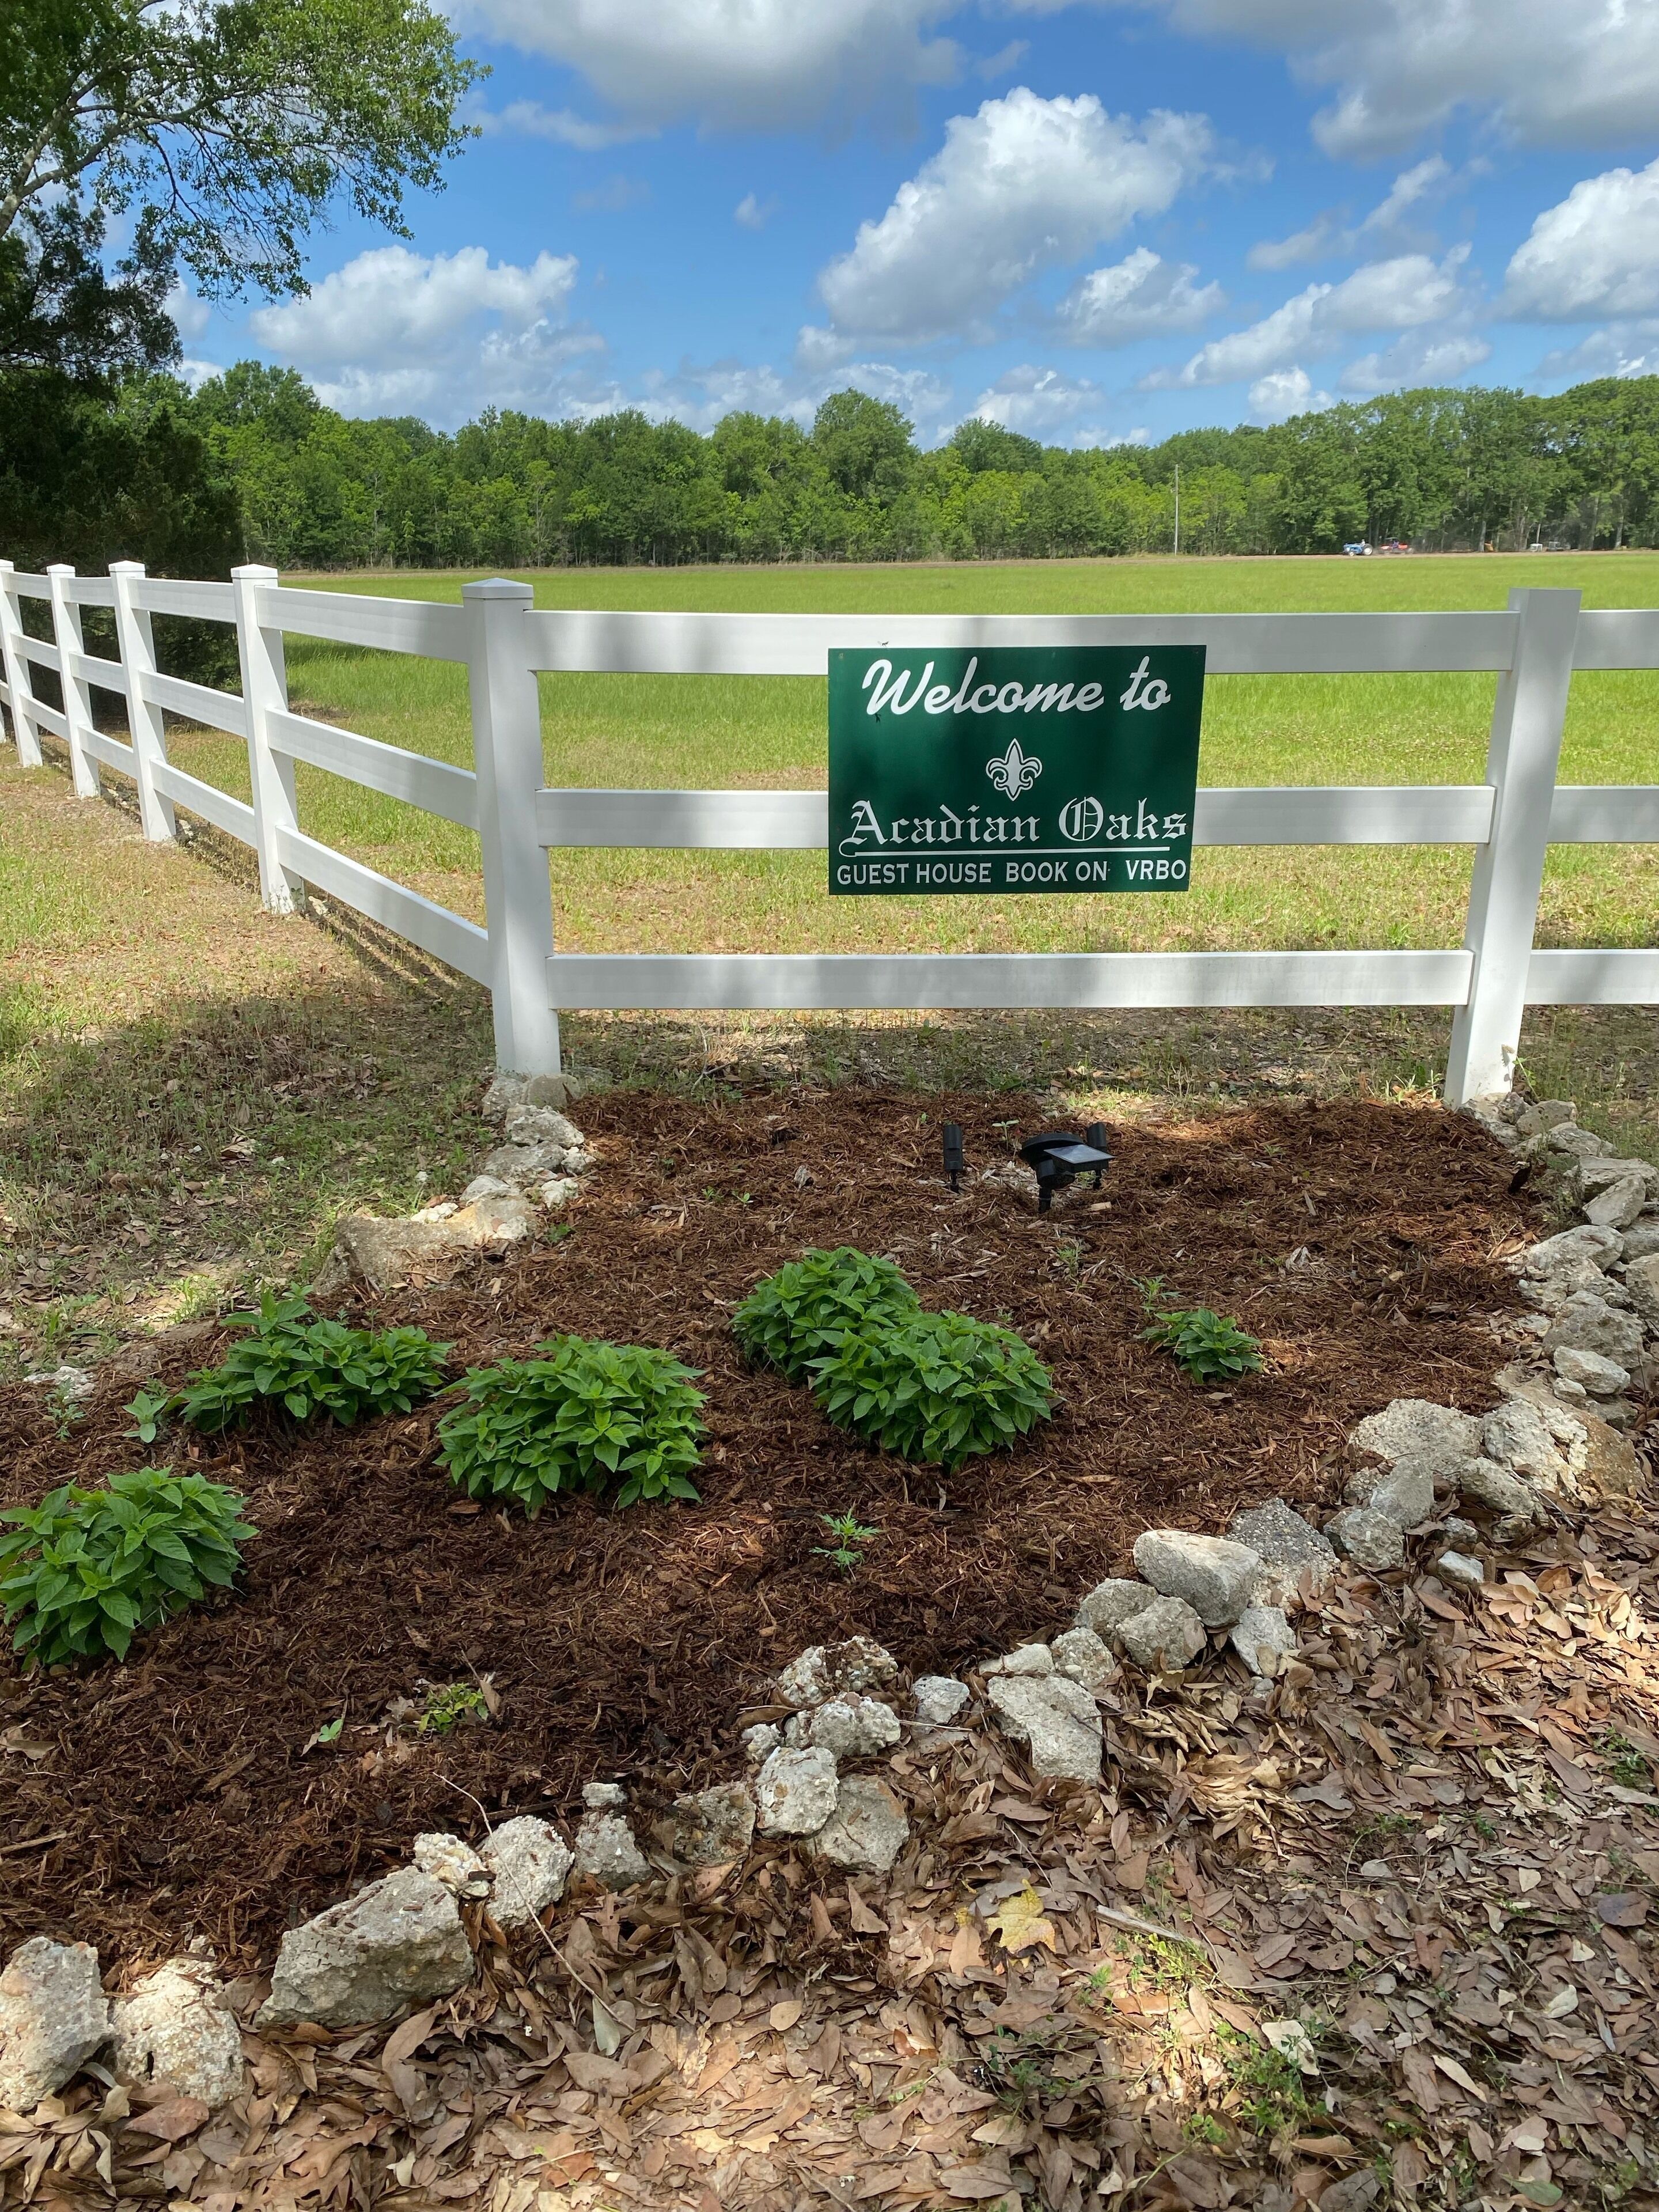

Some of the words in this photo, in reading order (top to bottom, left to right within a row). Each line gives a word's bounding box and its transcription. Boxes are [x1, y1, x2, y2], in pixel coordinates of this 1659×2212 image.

[862, 656, 1104, 715] Welcome
[1120, 656, 1171, 711] to
[840, 800, 1040, 847] Acadian
[1059, 796, 1187, 842] Oaks
[837, 863, 909, 885] GUEST
[916, 863, 991, 883] HOUSE
[1006, 862, 1069, 882] BOOK
[1075, 861, 1107, 881] ON
[1125, 859, 1187, 880] VRBO
